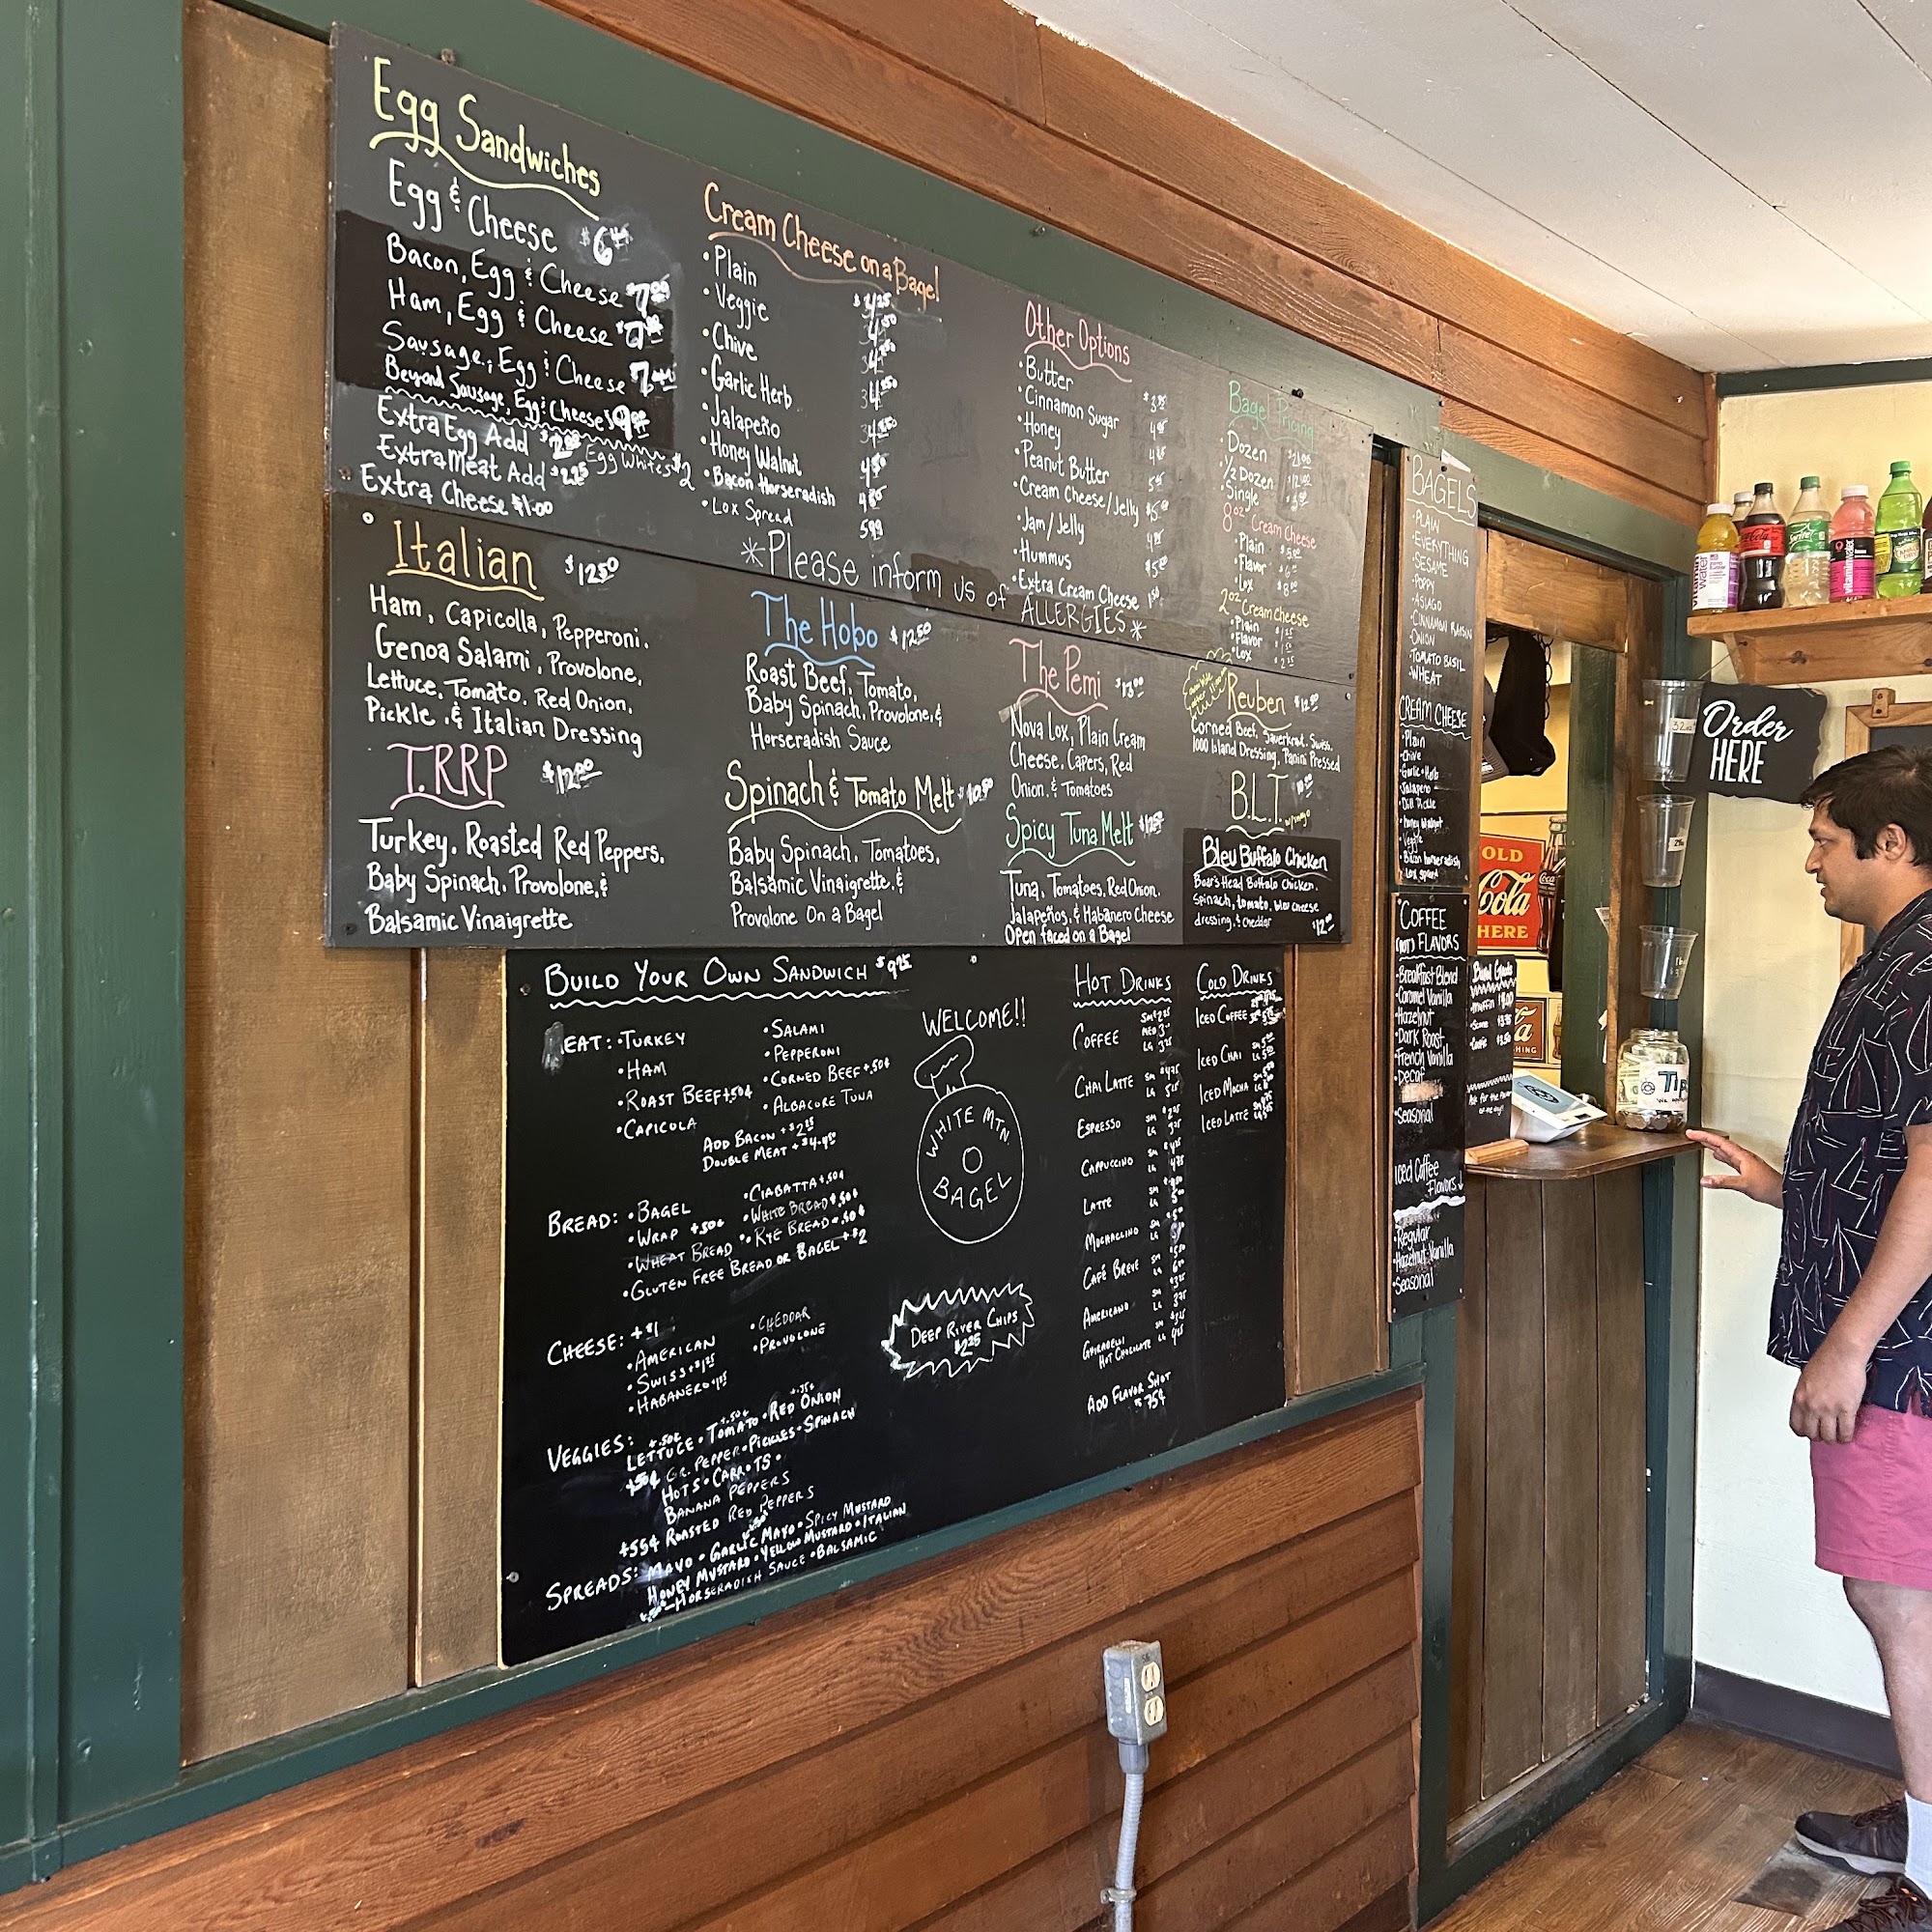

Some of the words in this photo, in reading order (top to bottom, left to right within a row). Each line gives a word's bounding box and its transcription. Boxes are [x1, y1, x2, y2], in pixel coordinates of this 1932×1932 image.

[374, 57, 440, 157] Egg
[456, 94, 600, 196] Sandwiches
[388, 158, 442, 231] Egg
[469, 195, 557, 253] Cheese
[704, 182, 777, 242] Cream
[782, 213, 857, 272] Cheese
[471, 248, 515, 300] Egg
[540, 264, 623, 307] Cheese
[715, 244, 757, 287] Plain
[715, 283, 769, 330] Veggie
[712, 322, 757, 360] Chive
[1026, 300, 1074, 351] Other
[1079, 319, 1130, 365] Options
[498, 347, 536, 388] Egg
[555, 355, 625, 394] Cheese
[711, 357, 757, 399] Garlic
[760, 373, 792, 409] Herb
[1026, 355, 1073, 391] Butter
[1025, 385, 1084, 419] Cinnamon
[1088, 406, 1120, 439] Sugar
[377, 395, 440, 436] Extra
[444, 414, 477, 466] Egg
[484, 424, 528, 456] Add
[1024, 412, 1061, 450] Honey
[1228, 430, 1266, 463] Dozen
[710, 429, 751, 476] Honey
[360, 463, 433, 504] Extra
[441, 485, 508, 515] Cheese
[1240, 466, 1273, 490] Dozen
[1412, 454, 1477, 519] BAGELS
[712, 497, 739, 516] Lox
[745, 498, 793, 526] Spread
[1226, 479, 1259, 512] Single
[1415, 508, 1439, 534] PLAIN
[1789, 529, 1811, 542] Sprite
[393, 521, 537, 590] Italian
[1020, 538, 1071, 570] Hummus
[1238, 532, 1264, 554] Plain
[1414, 531, 1469, 567] EVERYTHING
[1414, 552, 1448, 578] SESAME
[1019, 569, 1053, 594] Extra
[1059, 578, 1094, 601] Cream
[1098, 584, 1139, 611] Cheese
[1238, 574, 1253, 593] Lox
[1414, 573, 1435, 594] POPPY
[1242, 599, 1272, 620] Cream
[1274, 606, 1309, 628] Cheese
[1414, 597, 1442, 611] ASIAGO
[1411, 628, 1435, 647] ONION
[1413, 610, 1447, 634] CINNAMON
[746, 653, 797, 689] Roast
[1410, 647, 1442, 666] TOMATO
[1444, 654, 1465, 672] BASIL
[1410, 666, 1442, 685] WHEAT
[535, 690, 570, 711] Red
[746, 685, 793, 726] Baby
[1399, 695, 1433, 722] CREAM
[1435, 703, 1467, 729] CHEESE
[473, 708, 545, 738] Italian
[554, 717, 642, 758] Dressing
[1009, 705, 1043, 740] Nova
[1077, 715, 1109, 747] Plain
[1113, 719, 1146, 751] Cream
[1702, 699, 1794, 743] Order
[751, 722, 840, 751] Horseradish
[847, 724, 891, 753] Sauce
[1405, 729, 1426, 748] Plain
[1110, 753, 1133, 778] Red
[1710, 739, 1767, 783] HERE
[724, 759, 825, 824] Spinach
[844, 777, 906, 810] Tomato
[915, 775, 954, 813] Melt
[1061, 777, 1113, 798] Tomatoes
[466, 821, 541, 865] Roasted
[554, 826, 590, 865] Red
[1006, 803, 1055, 859] Spicy
[1061, 811, 1097, 845] Tuna
[1101, 810, 1133, 846] Melt
[1482, 846, 1523, 862] OLD
[367, 862, 415, 903] Baby
[364, 903, 458, 934] Balsamic
[461, 904, 574, 938] Vinaigrette
[1083, 905, 1131, 923] Habanero
[1134, 904, 1175, 923] Cheese
[1401, 900, 1447, 930] COFFEE
[1005, 924, 1036, 946] Open
[1098, 925, 1131, 945] Bagel
[1418, 932, 1460, 952] FLAVORS
[1478, 924, 1528, 939] HERE
[544, 964, 618, 997] BUILD
[635, 958, 688, 992] YOUR
[703, 956, 760, 986] OWN
[773, 955, 867, 983] SANDWICH
[1075, 963, 1111, 997] HOT
[1120, 967, 1172, 995] DRINKS
[1196, 963, 1227, 995] COLD
[1232, 964, 1273, 987] DRINKS
[1436, 967, 1459, 986] Blend
[620, 1030, 686, 1048] TURKEY
[772, 1019, 825, 1038] SALAMI
[1073, 1023, 1120, 1051] COFFEE
[1398, 1028, 1419, 1046] Dark
[1422, 1030, 1445, 1049] Roast
[627, 1059, 668, 1079] HAM
[1105, 1070, 1134, 1093] LATTE
[1398, 1067, 1426, 1085] Decaf
[626, 1089, 674, 1111] ROAST
[1397, 1102, 1434, 1124] Seasonal
[1077, 1119, 1121, 1139] ESPRESSO
[932, 1172, 1012, 1210] BAGEL
[1395, 1266, 1434, 1294] Seasonal
[635, 1335, 715, 1372] AMERICAN
